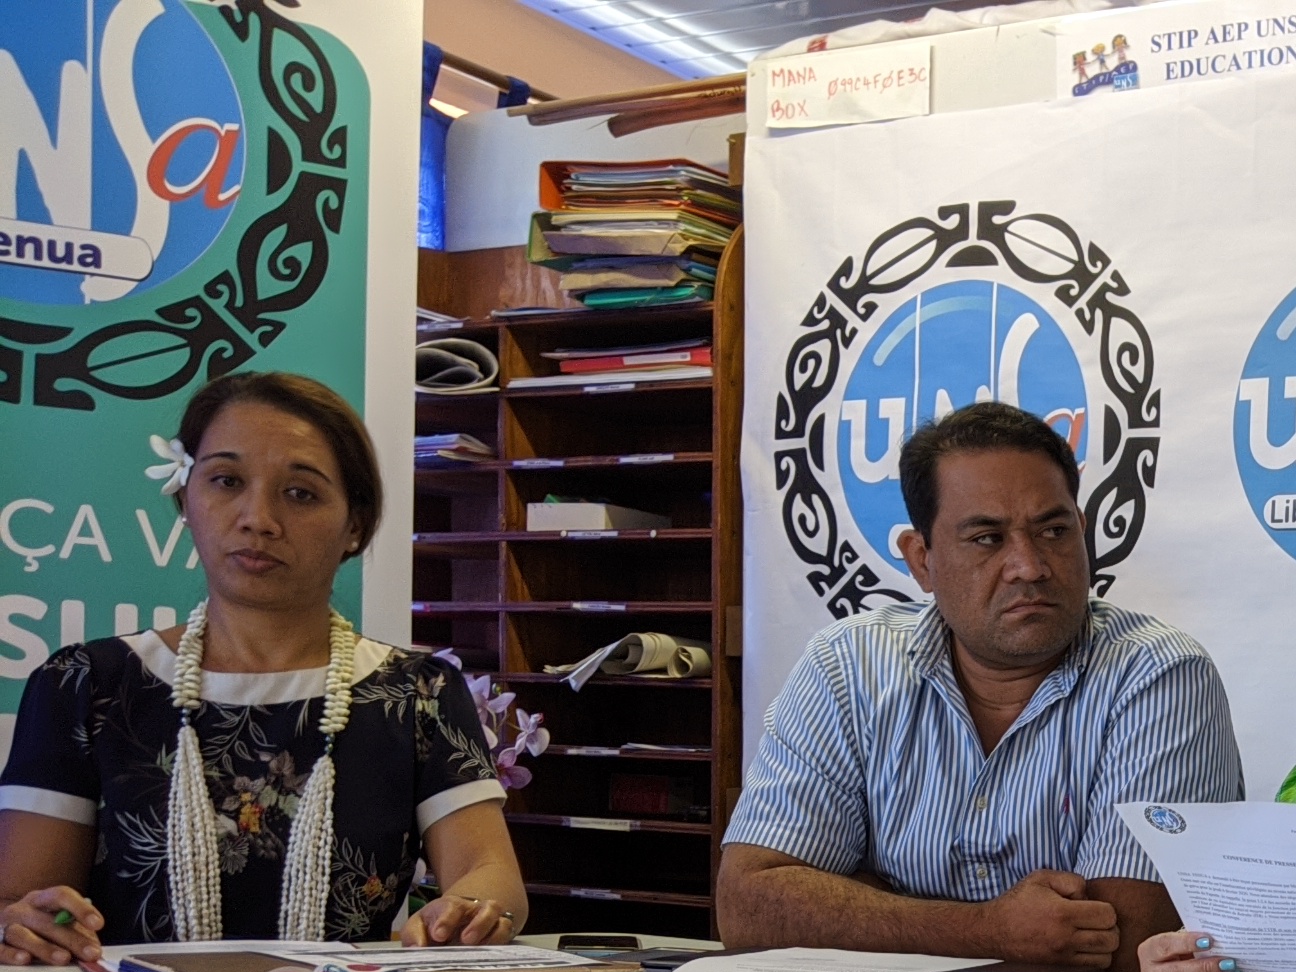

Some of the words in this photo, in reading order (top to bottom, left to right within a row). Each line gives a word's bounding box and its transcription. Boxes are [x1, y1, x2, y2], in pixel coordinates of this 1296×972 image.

[1150, 29, 1199, 53] STIP
[1205, 22, 1249, 46] AEP
[771, 66, 817, 88] MANA
[771, 99, 809, 120] BOX
[0, 231, 103, 270] enua
[0, 498, 113, 572] ÇA
